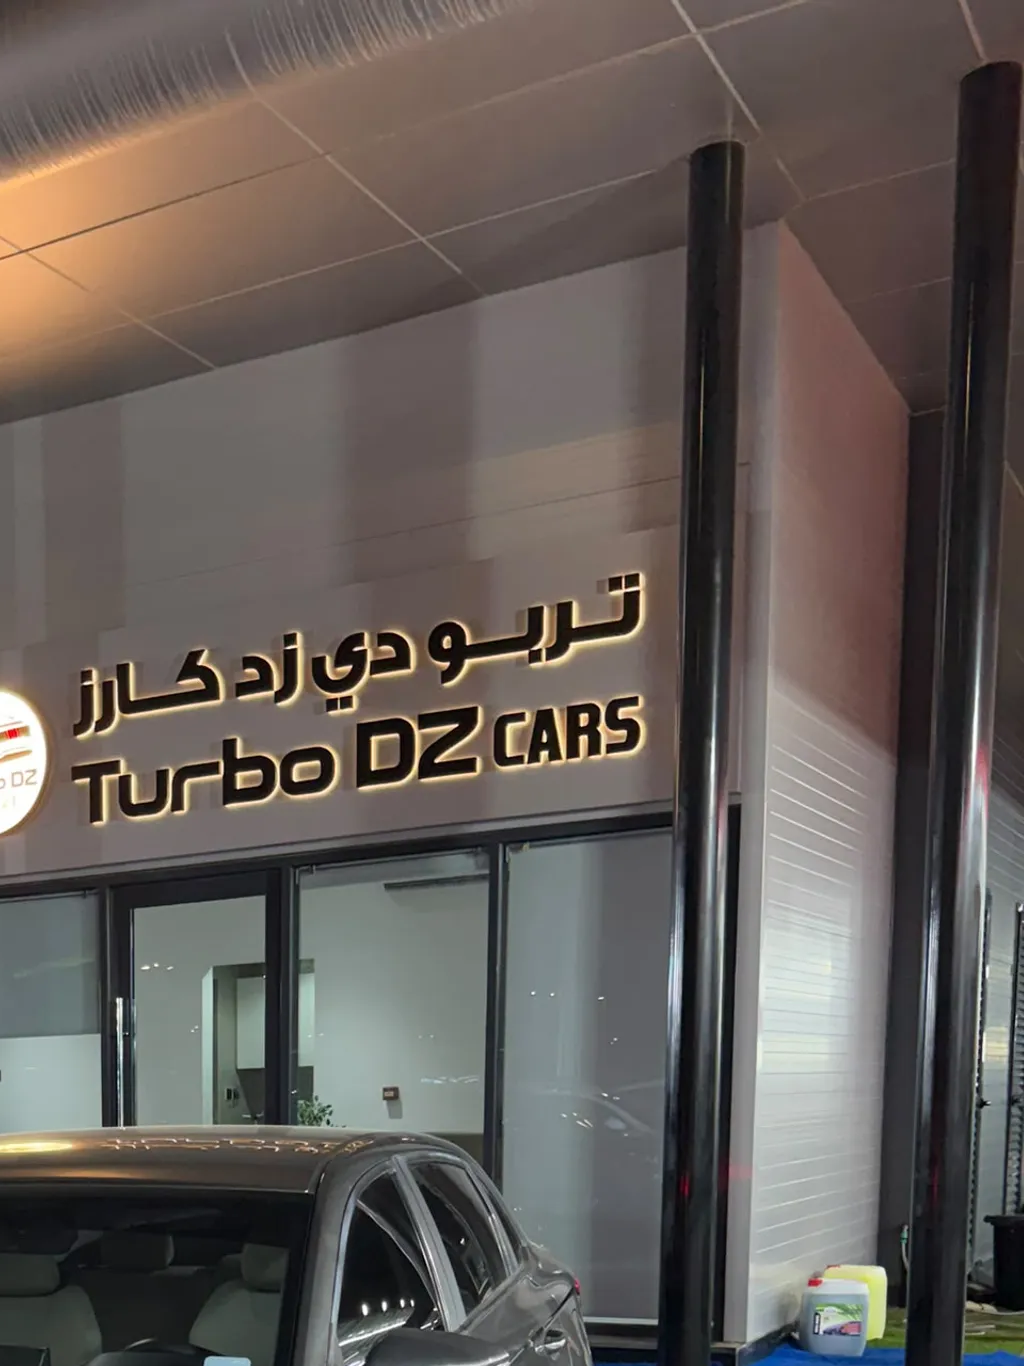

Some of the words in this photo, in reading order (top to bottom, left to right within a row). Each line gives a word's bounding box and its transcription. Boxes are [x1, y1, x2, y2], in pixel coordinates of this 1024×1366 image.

[234, 631, 299, 705] زد
[428, 572, 641, 685] تربو
[73, 648, 221, 737] كارز
[311, 631, 412, 713] دي
[11, 768, 38, 788] DZ
[71, 737, 336, 823] Turbo
[356, 706, 478, 788] DZ
[493, 696, 641, 768] CARS
